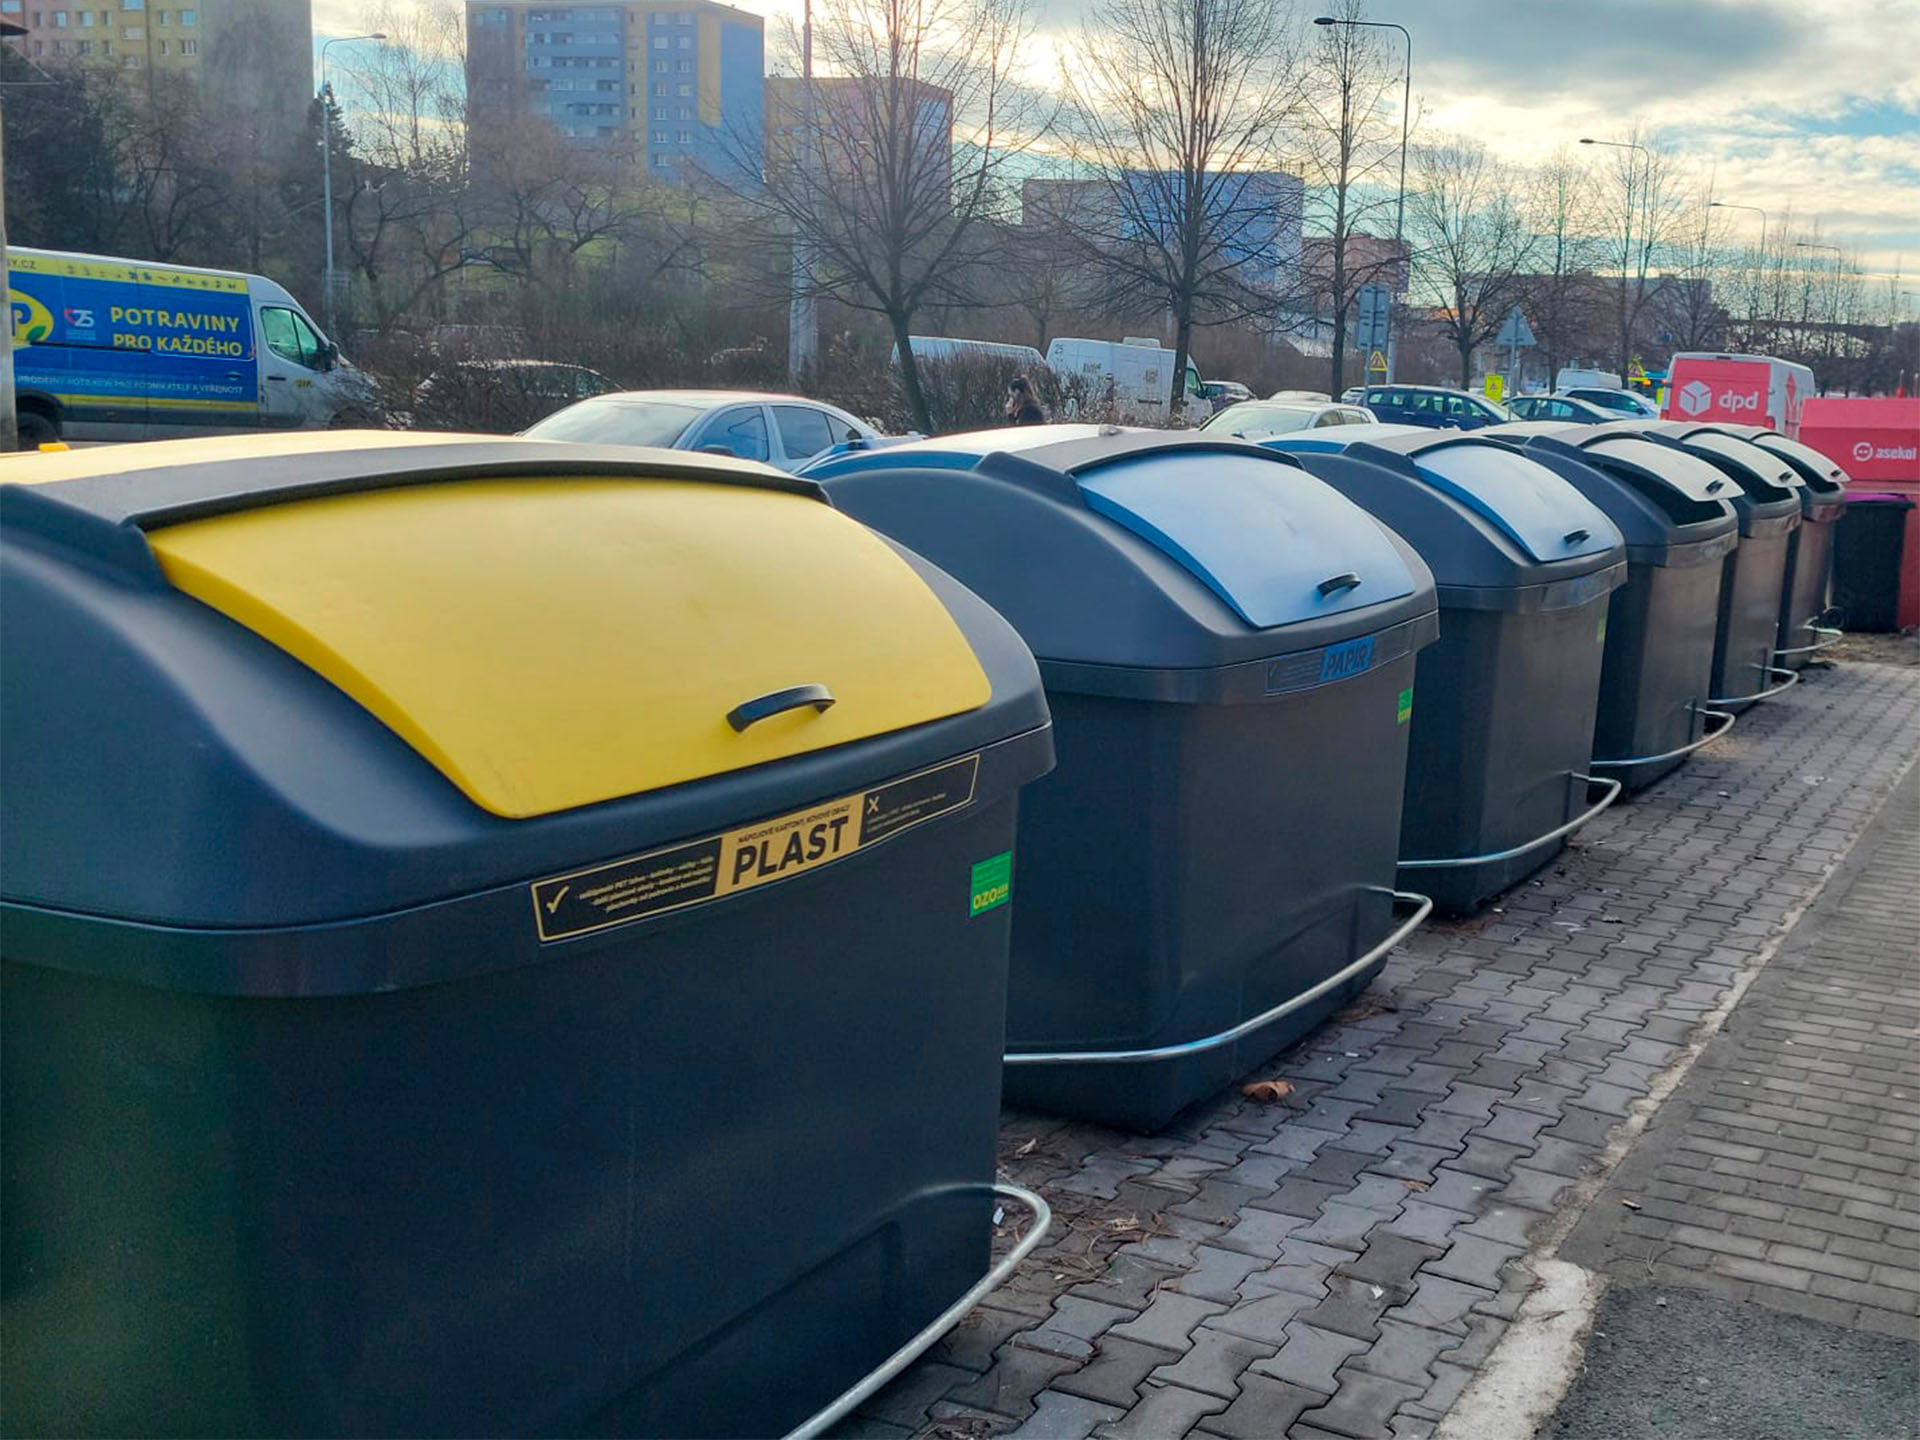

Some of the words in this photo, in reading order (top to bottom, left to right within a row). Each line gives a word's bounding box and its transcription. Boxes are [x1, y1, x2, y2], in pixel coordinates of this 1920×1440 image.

[110, 306, 240, 333] POTRAVINY
[113, 333, 152, 349] PRO
[156, 334, 243, 356] KAŽDÉHO
[1718, 389, 1759, 413] dpd
[1875, 446, 1918, 461] asekol
[732, 815, 850, 885] PLAST
